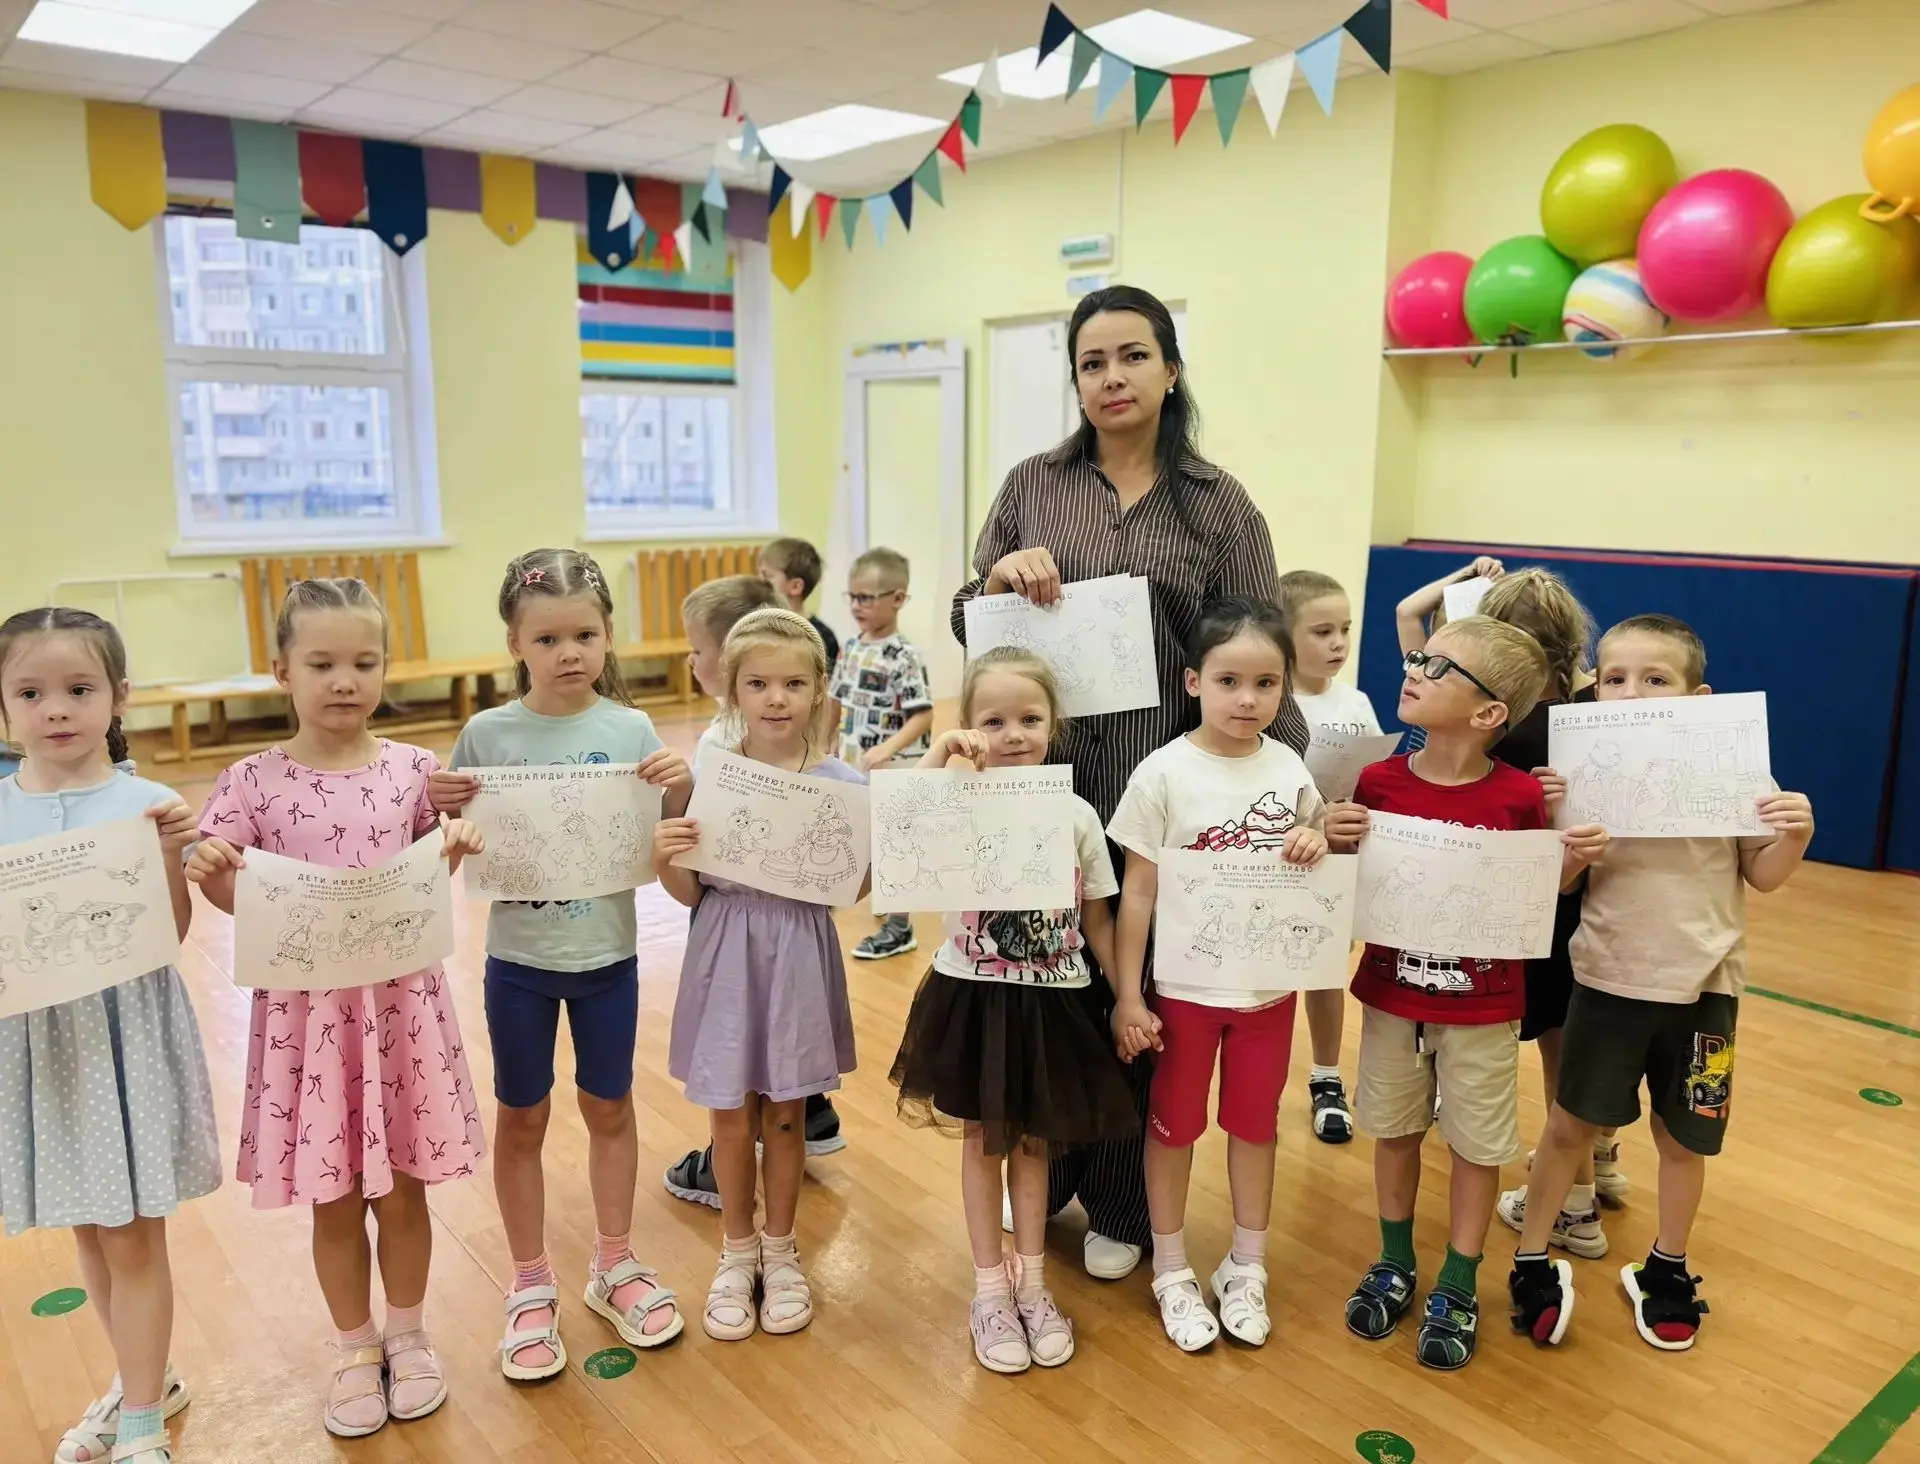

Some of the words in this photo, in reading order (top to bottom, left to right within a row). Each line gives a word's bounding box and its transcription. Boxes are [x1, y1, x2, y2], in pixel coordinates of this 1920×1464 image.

[1004, 599, 1030, 607] ИМЕЮ
[1553, 717, 1581, 727] ДЕТИ
[1586, 713, 1627, 723] ИМЕЮТ
[1633, 710, 1674, 720] ПРАВО
[473, 772, 564, 781] ЕТИ-ИНВАЛИДЫ
[570, 771, 609, 780] ИМЕЮТ
[615, 769, 635, 777] ПРА
[721, 763, 747, 776] ДЕТИ
[751, 772, 785, 788] ИМЕЮТ
[788, 783, 820, 795] ПРАВО
[963, 782, 990, 791] ДЕТИ
[996, 781, 1032, 789] ИМЕЮТ
[1038, 780, 1071, 788] ПРАВО
[1372, 824, 1392, 834] ЕТИ
[1398, 829, 1437, 842] ИМЕЮТ
[1443, 838, 1482, 850] ПРАВО
[52, 840, 96, 857] ПРАВО
[297, 873, 326, 884] ДЕТИ
[333, 877, 372, 886] ИМЕЮТ
[379, 861, 410, 880] ПРАВО
[1212, 863, 1238, 871] ДЕТИ
[1243, 864, 1276, 872] ИМЕЮТ
[1281, 865, 1313, 873] ПРАВО
